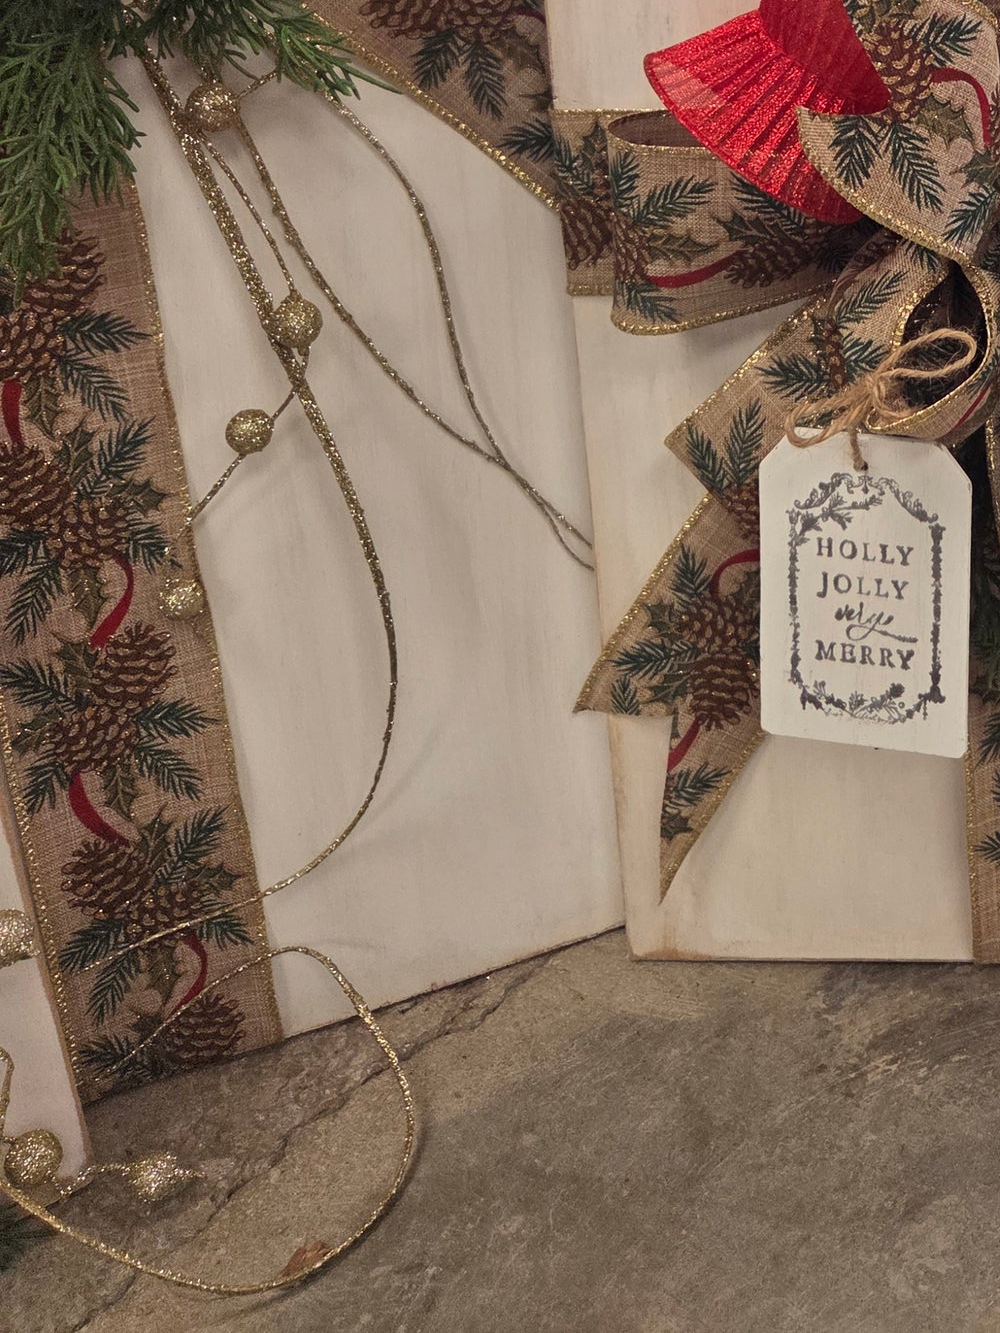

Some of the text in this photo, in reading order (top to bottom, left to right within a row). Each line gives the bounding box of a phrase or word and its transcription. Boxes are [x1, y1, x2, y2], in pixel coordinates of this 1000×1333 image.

[816, 536, 914, 566] HOLLY
[816, 571, 909, 600] JOLLY
[834, 601, 918, 643] very
[815, 639, 915, 671] MERRY
